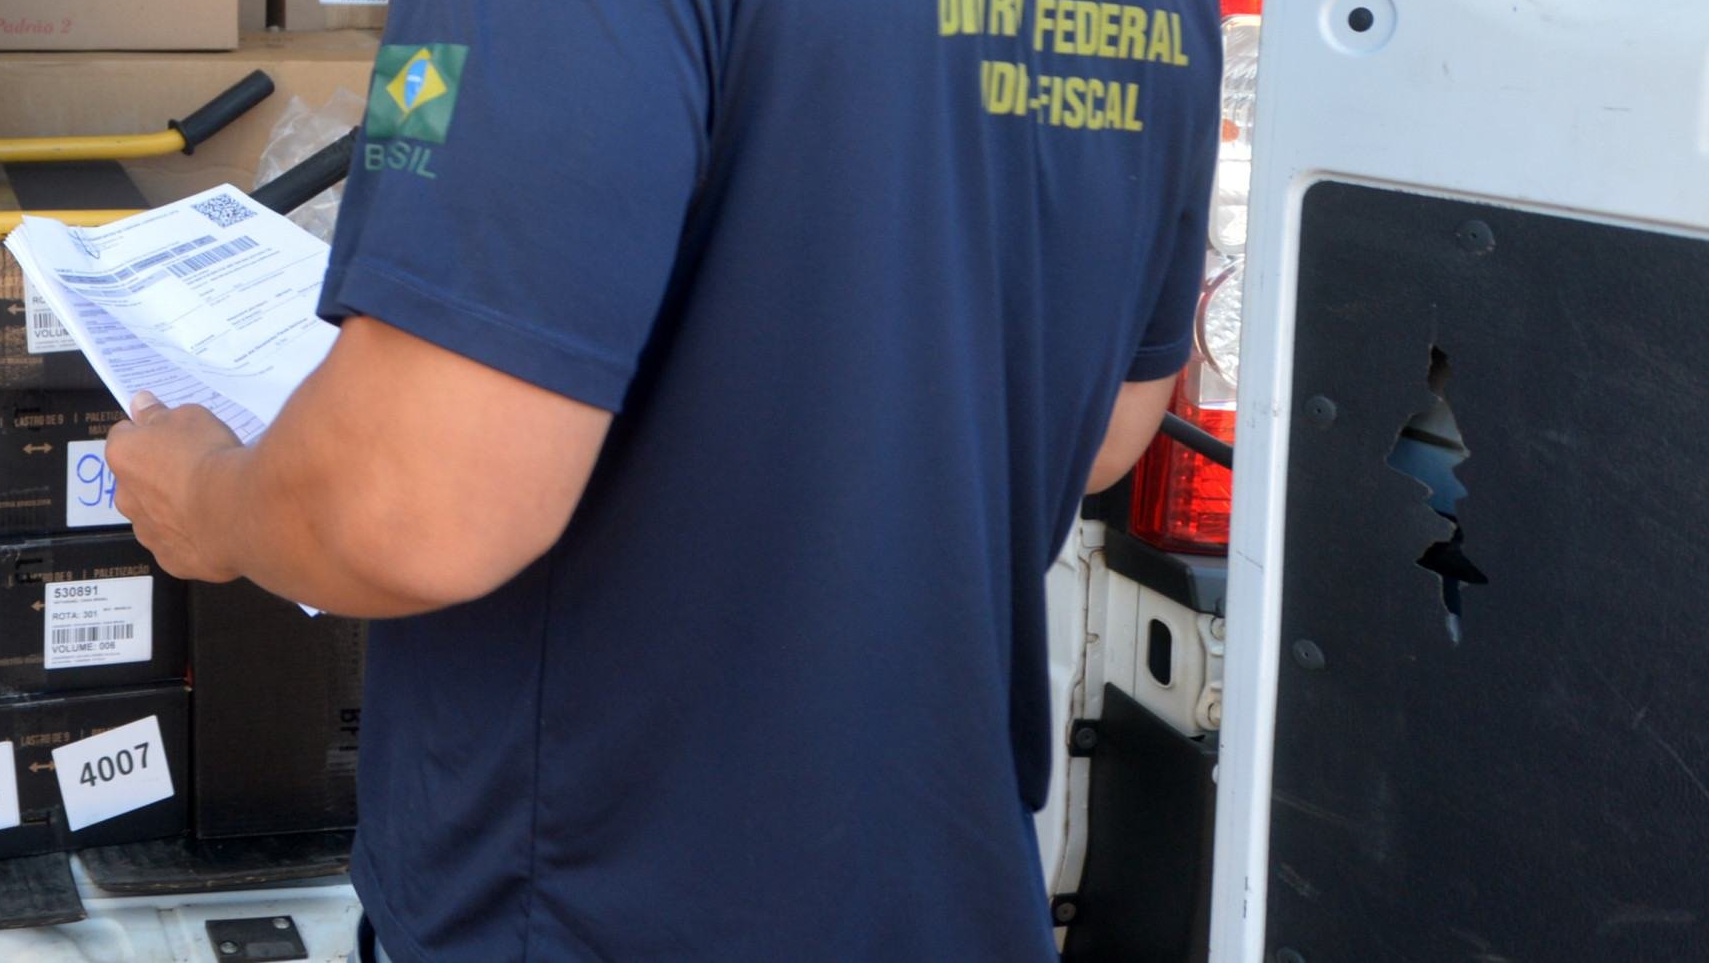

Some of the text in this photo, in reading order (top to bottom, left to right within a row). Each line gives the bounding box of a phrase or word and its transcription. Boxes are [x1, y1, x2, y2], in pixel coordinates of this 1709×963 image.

[59, 18, 72, 34] 2
[34, 328, 71, 339] VOLUM
[54, 585, 99, 598] 530891
[52, 612, 80, 621] ROTA:
[52, 642, 96, 654] VOLUME:
[80, 742, 149, 787] 4007
